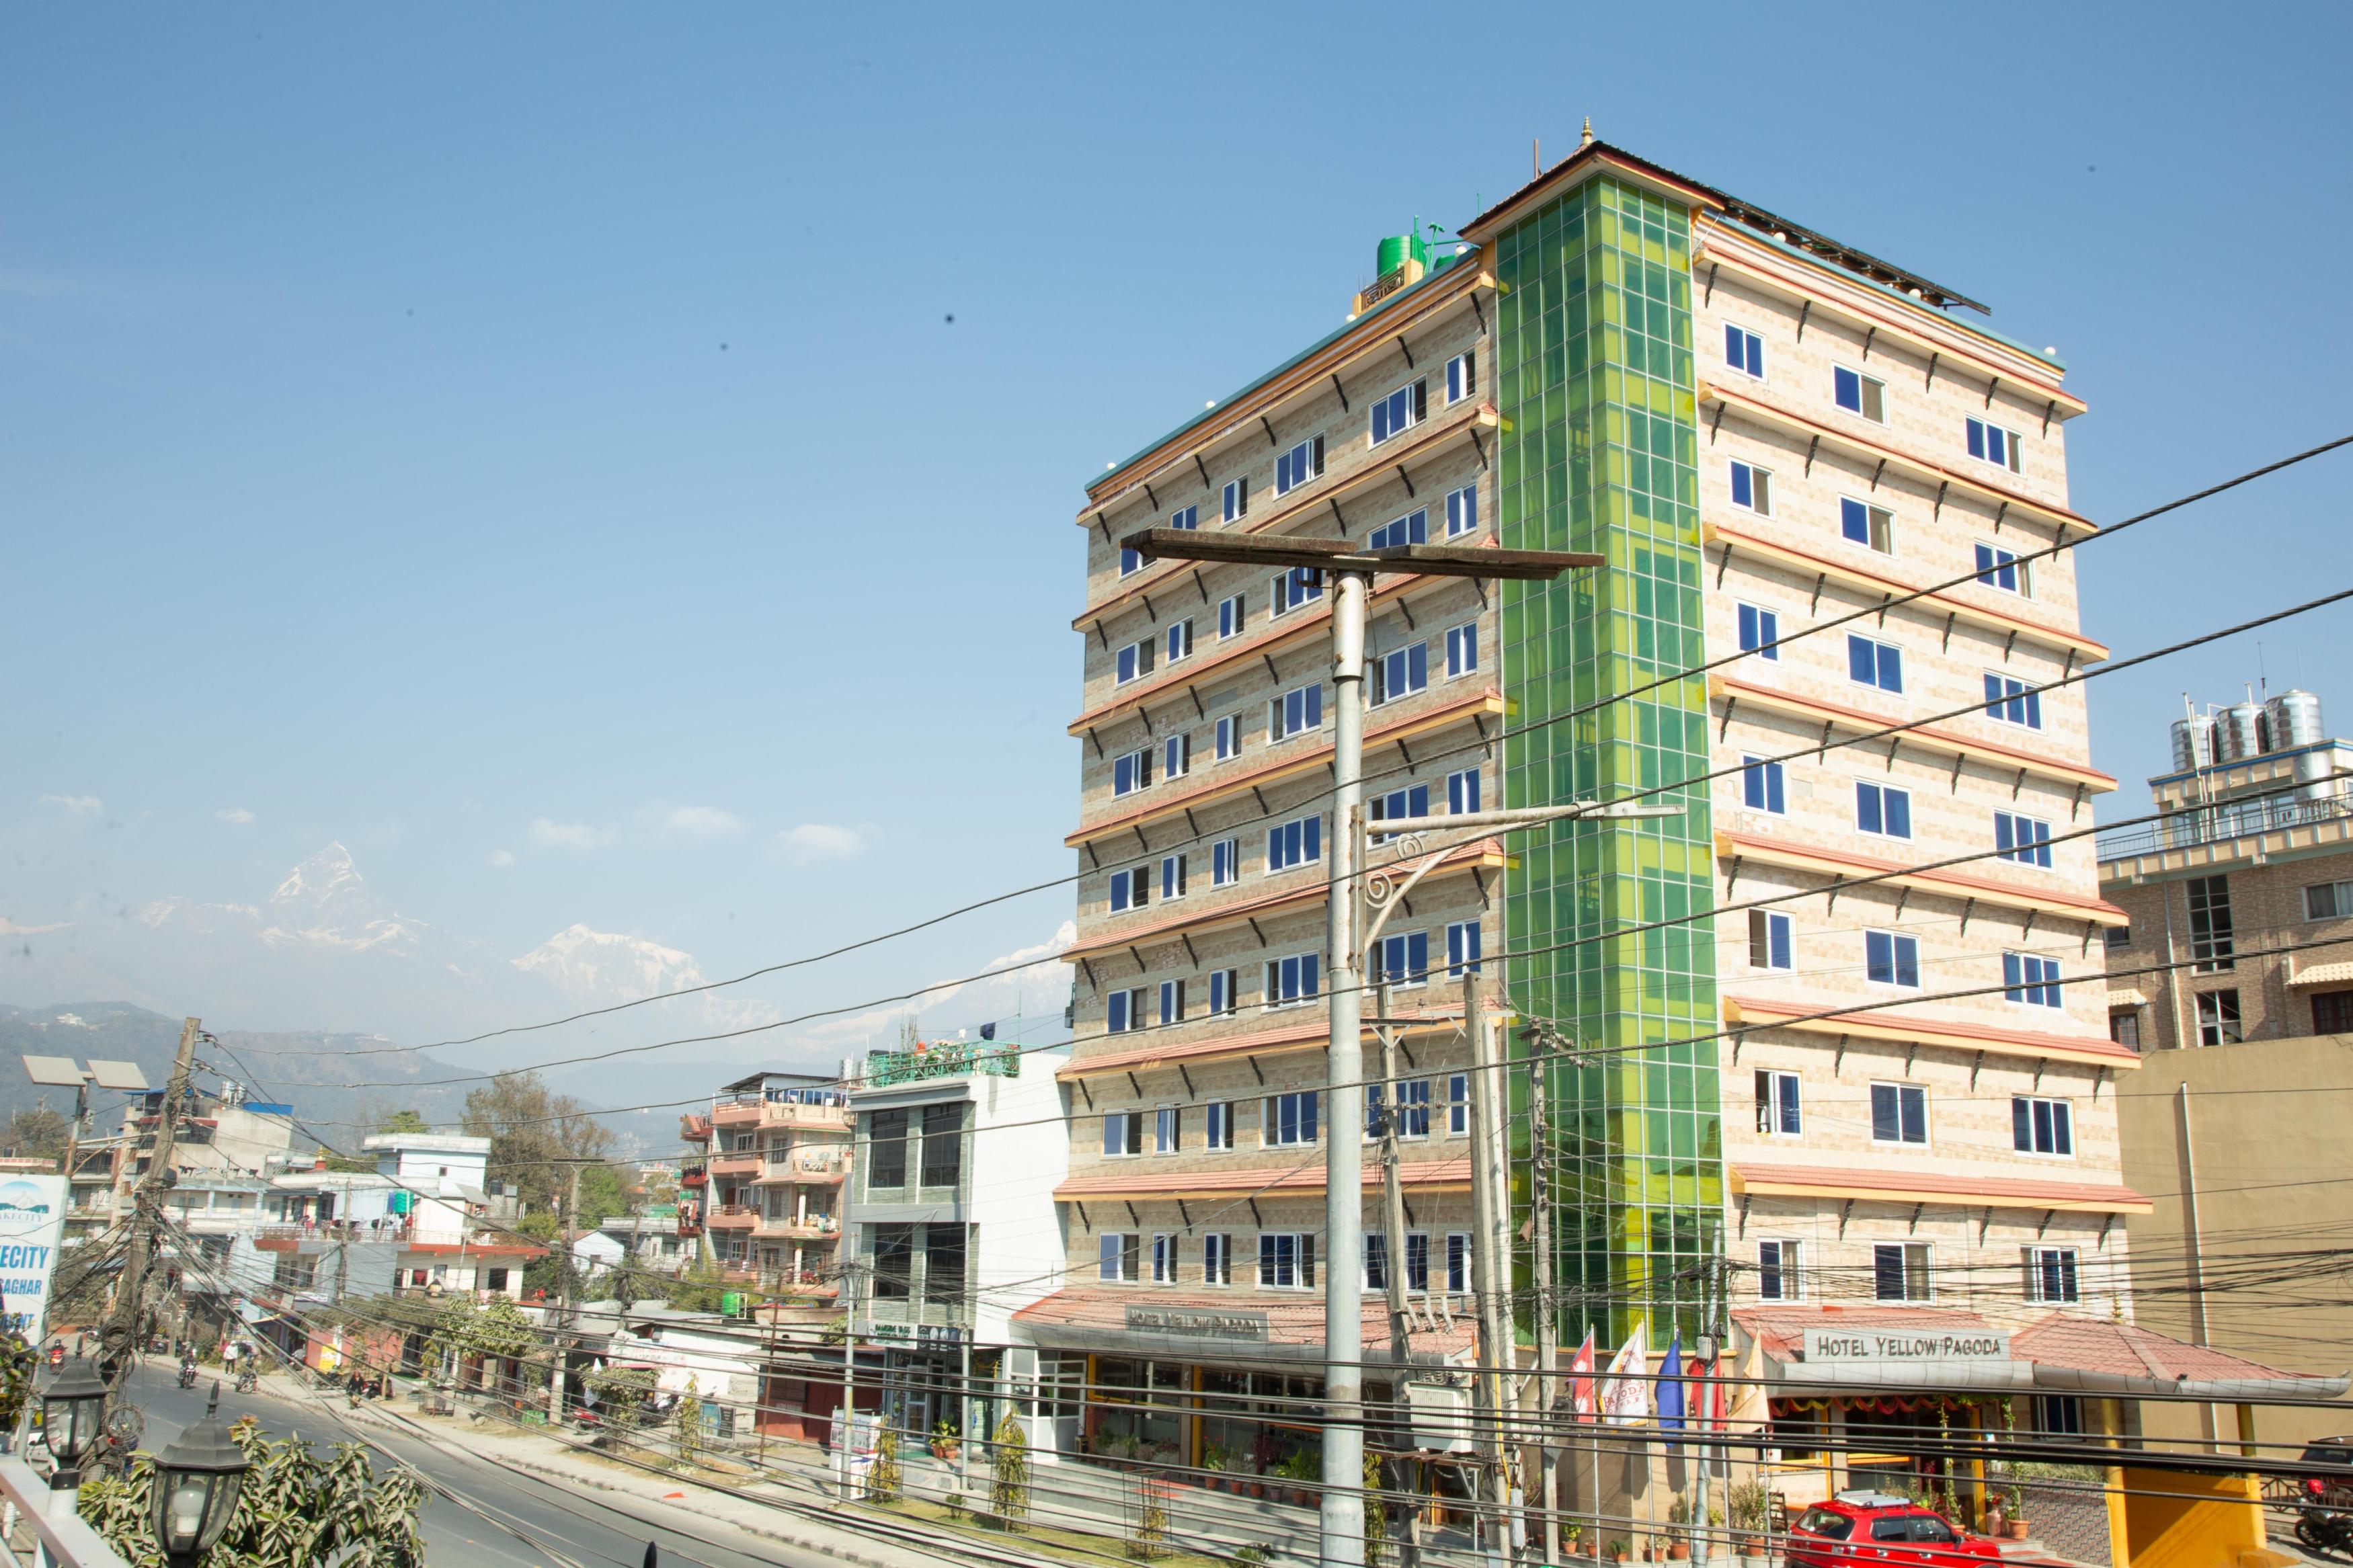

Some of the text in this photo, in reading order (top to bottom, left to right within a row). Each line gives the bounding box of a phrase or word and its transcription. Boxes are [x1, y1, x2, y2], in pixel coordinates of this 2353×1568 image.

[0, 1212, 42, 1222] KECITY
[0, 1245, 50, 1269] ECITY
[1818, 1335, 2001, 1356] HOTEL YELLOW PAGODA
